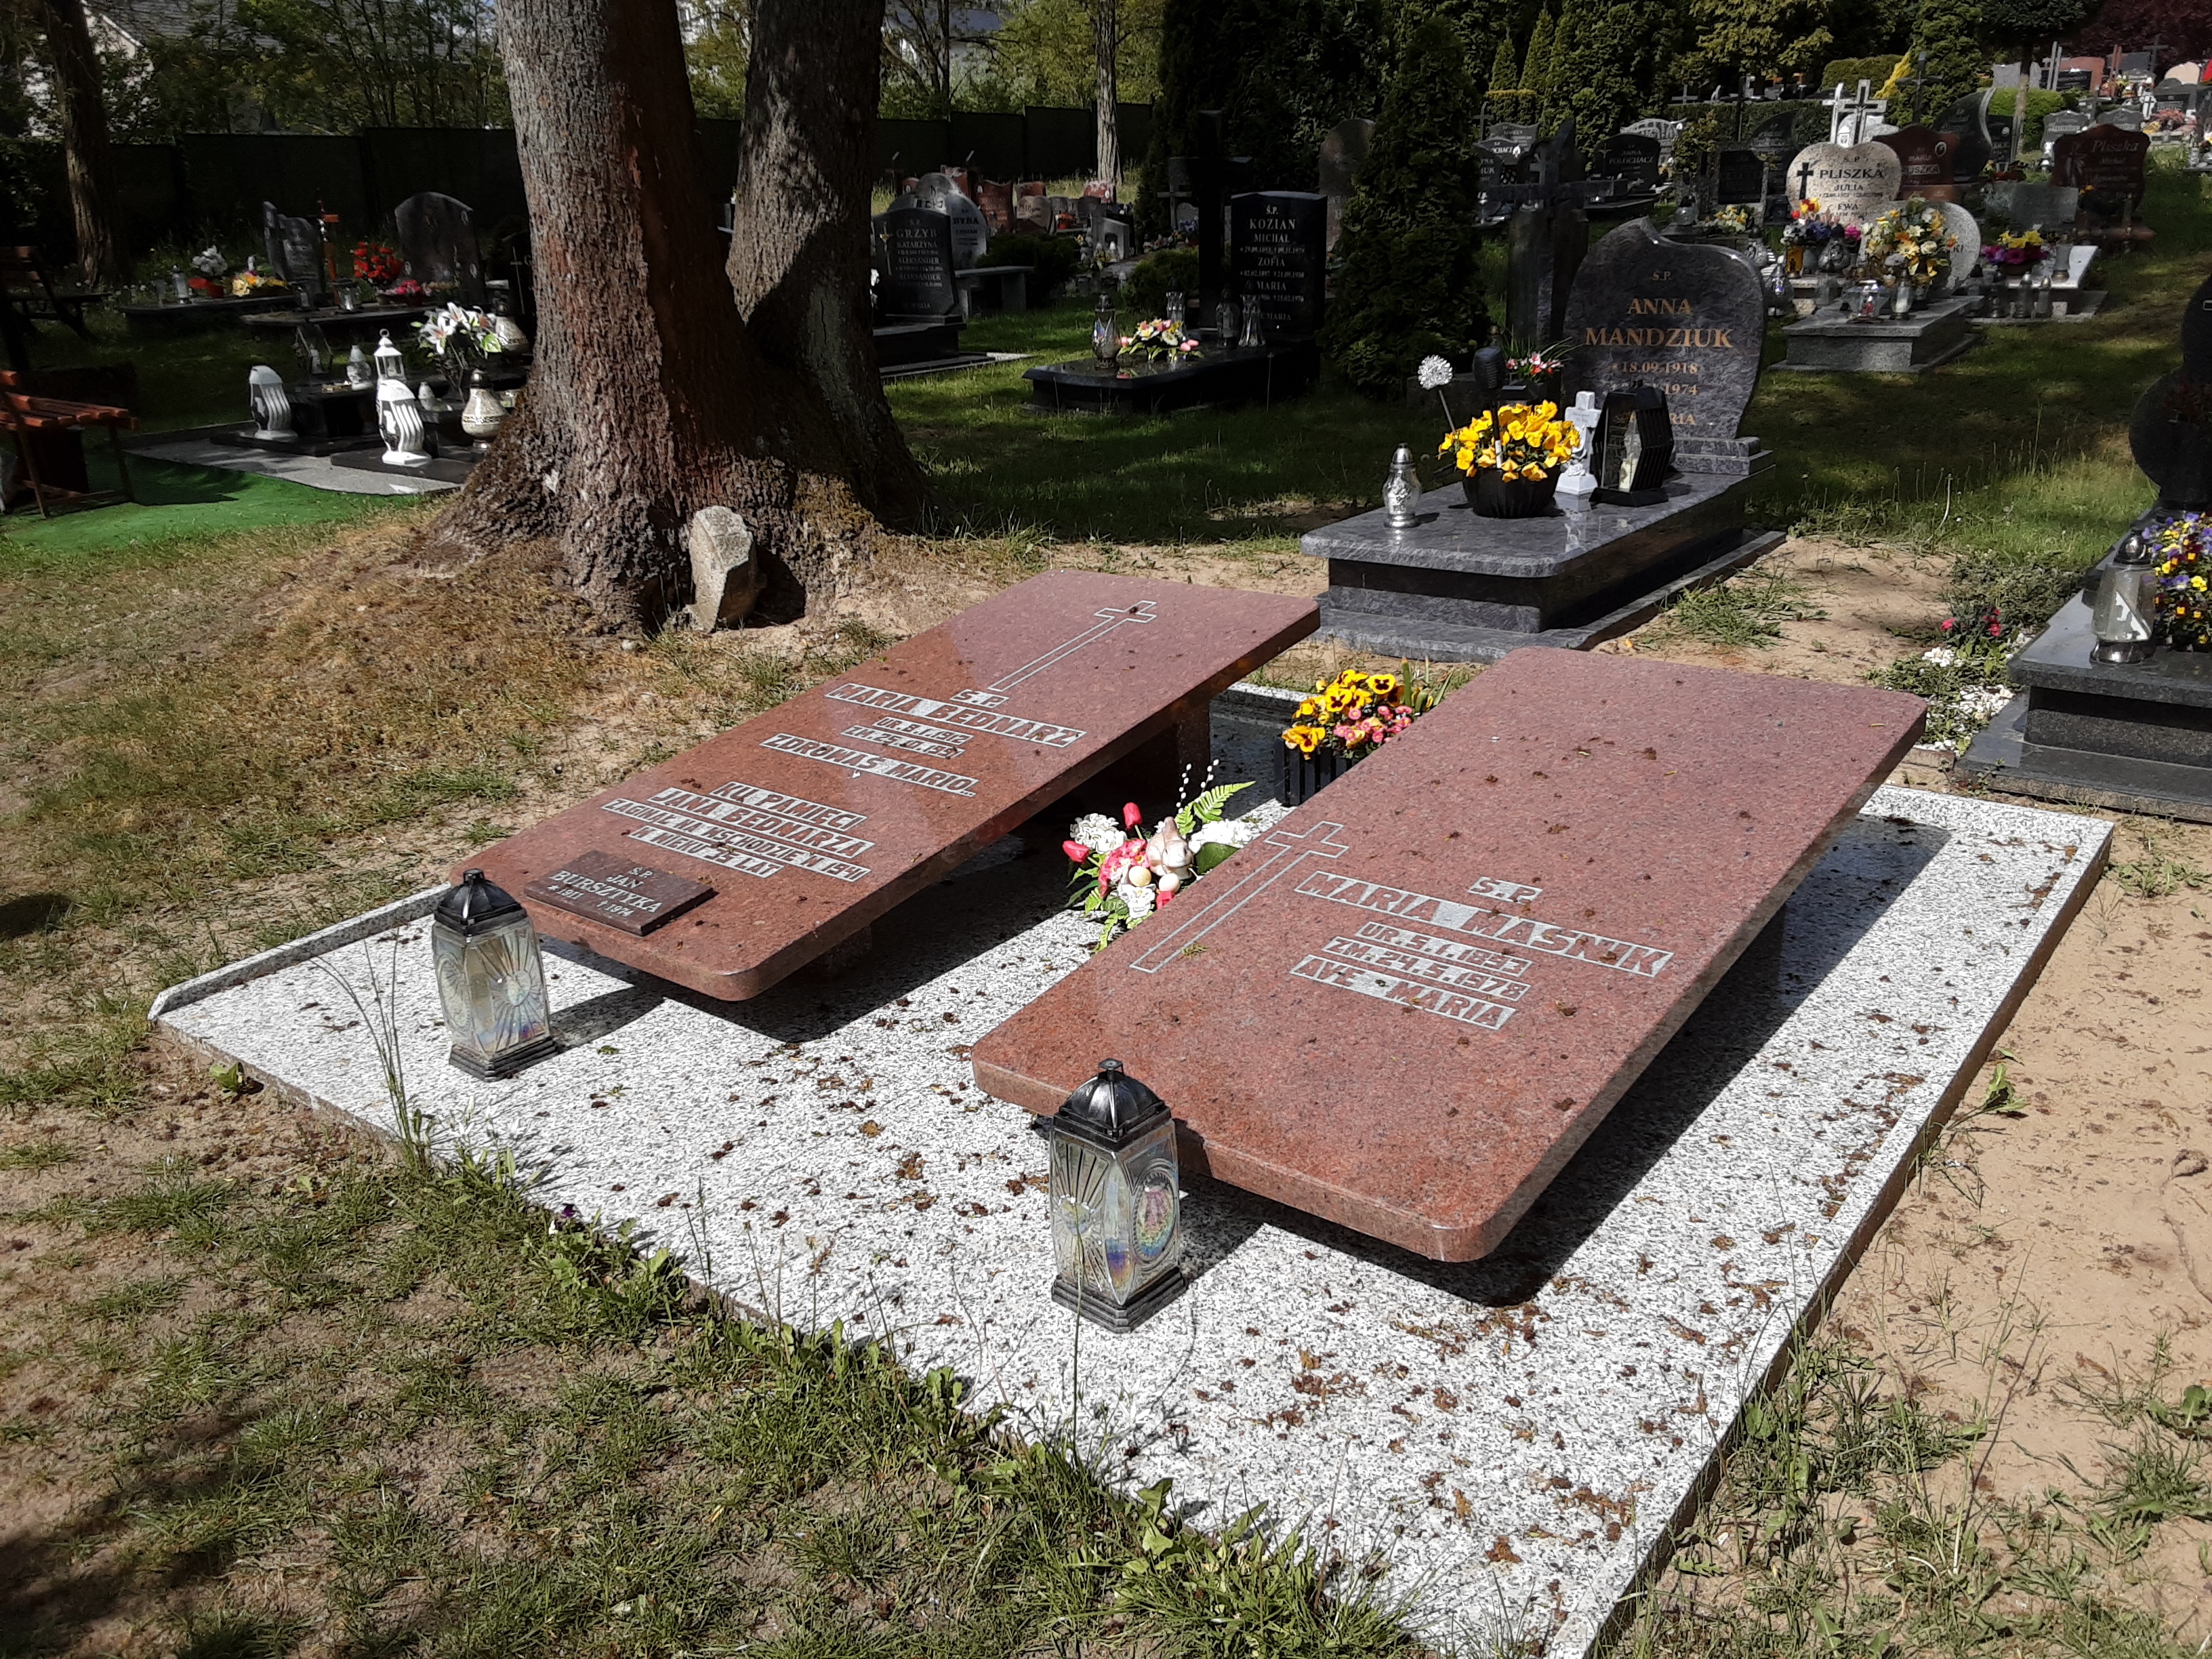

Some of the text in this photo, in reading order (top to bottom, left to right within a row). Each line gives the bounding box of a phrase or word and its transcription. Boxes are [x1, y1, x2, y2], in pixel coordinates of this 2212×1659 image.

[1819, 169, 1885, 179] PLISZKA
[896, 228, 937, 238] GRZYB
[1249, 218, 1296, 230] KOZIAN
[1258, 257, 1286, 267] ZOFIA
[1256, 280, 1287, 291] MARIA
[1627, 298, 1694, 315] ANNA
[1584, 327, 1734, 348] MANDZIUK
[828, 684, 921, 712] MARIA
[926, 705, 1079, 747] BEDNARZ
[651, 789, 720, 815] JANA
[714, 783, 758, 803] KU
[673, 819, 703, 833] NA
[701, 826, 805, 862] WSCHODZIE
[722, 808, 866, 858] BEDNARZA
[631, 827, 655, 838] W
[650, 832, 710, 854] WIEKU
[733, 857, 781, 875] LAT
[549, 869, 663, 914] BURSZTYKA
[606, 874, 644, 889] JAN
[1304, 874, 1441, 922] MARIA
[1294, 958, 1359, 987] AVE
[1384, 981, 1502, 1025] MARIA
